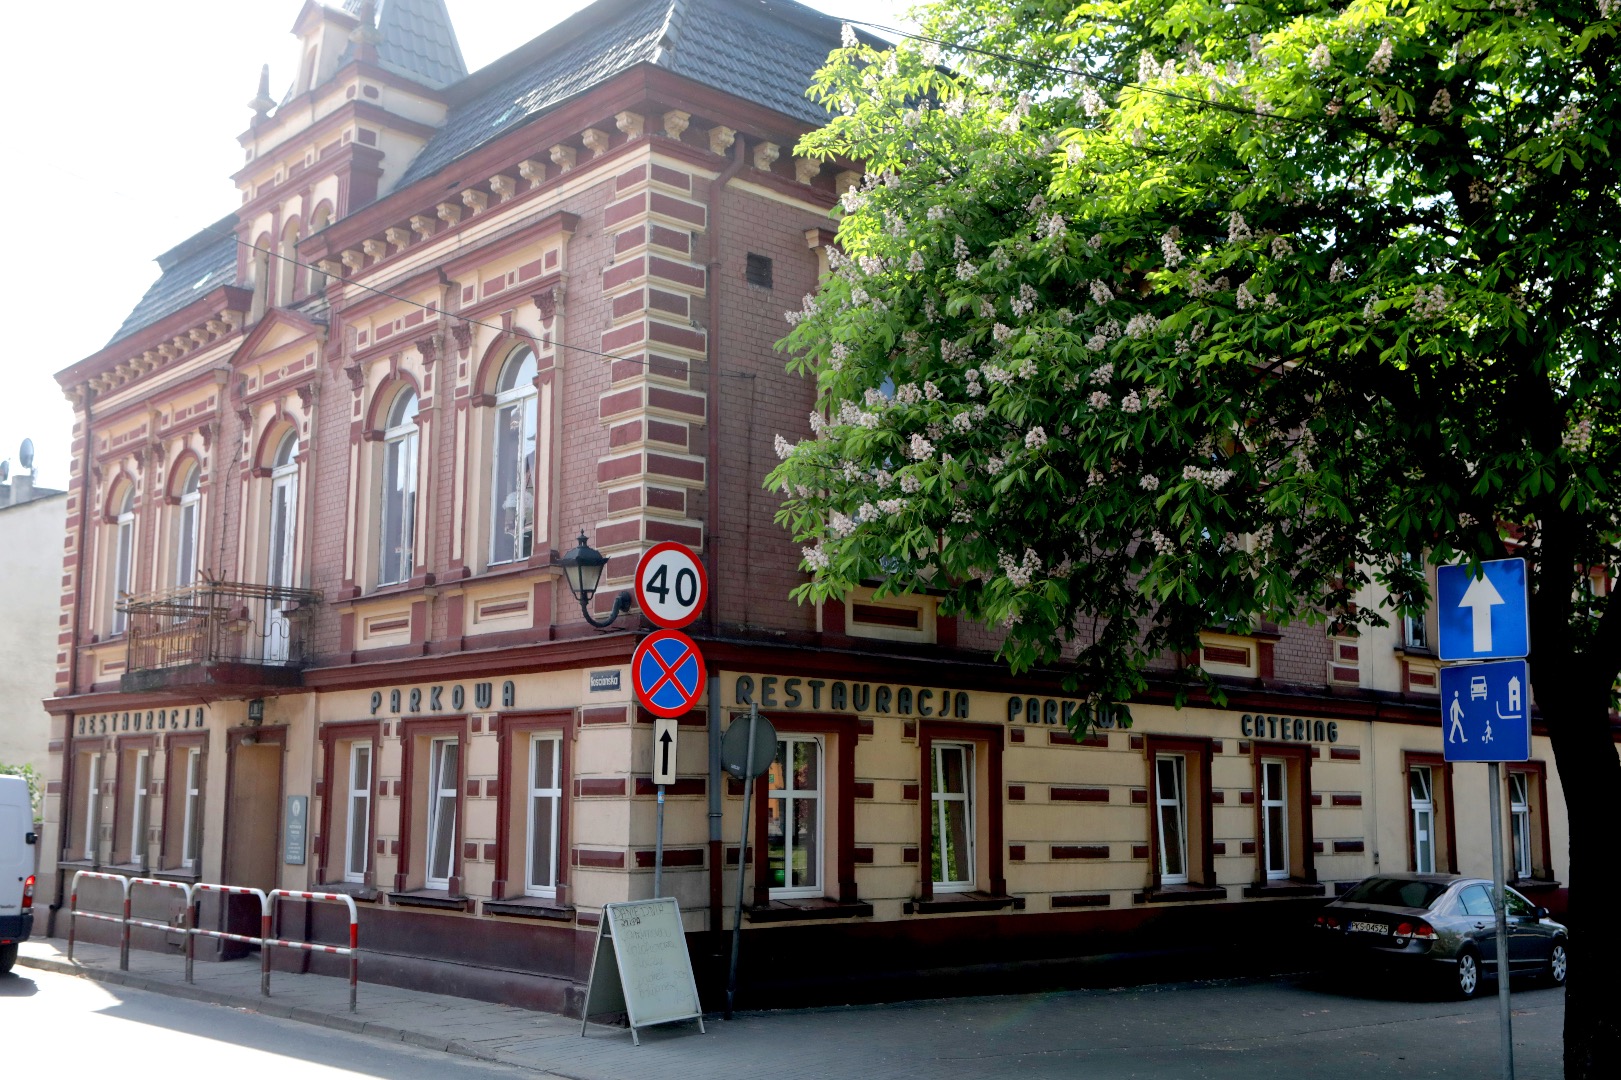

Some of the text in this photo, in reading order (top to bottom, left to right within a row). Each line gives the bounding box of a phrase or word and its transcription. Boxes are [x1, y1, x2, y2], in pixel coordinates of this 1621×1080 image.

[645, 564, 698, 608] 40
[370, 681, 515, 714] PARKOWA
[736, 675, 1132, 729] RESTAURACJA PARKW
[78, 707, 204, 735] RESTAURACJA
[1241, 714, 1339, 743] CATERING
